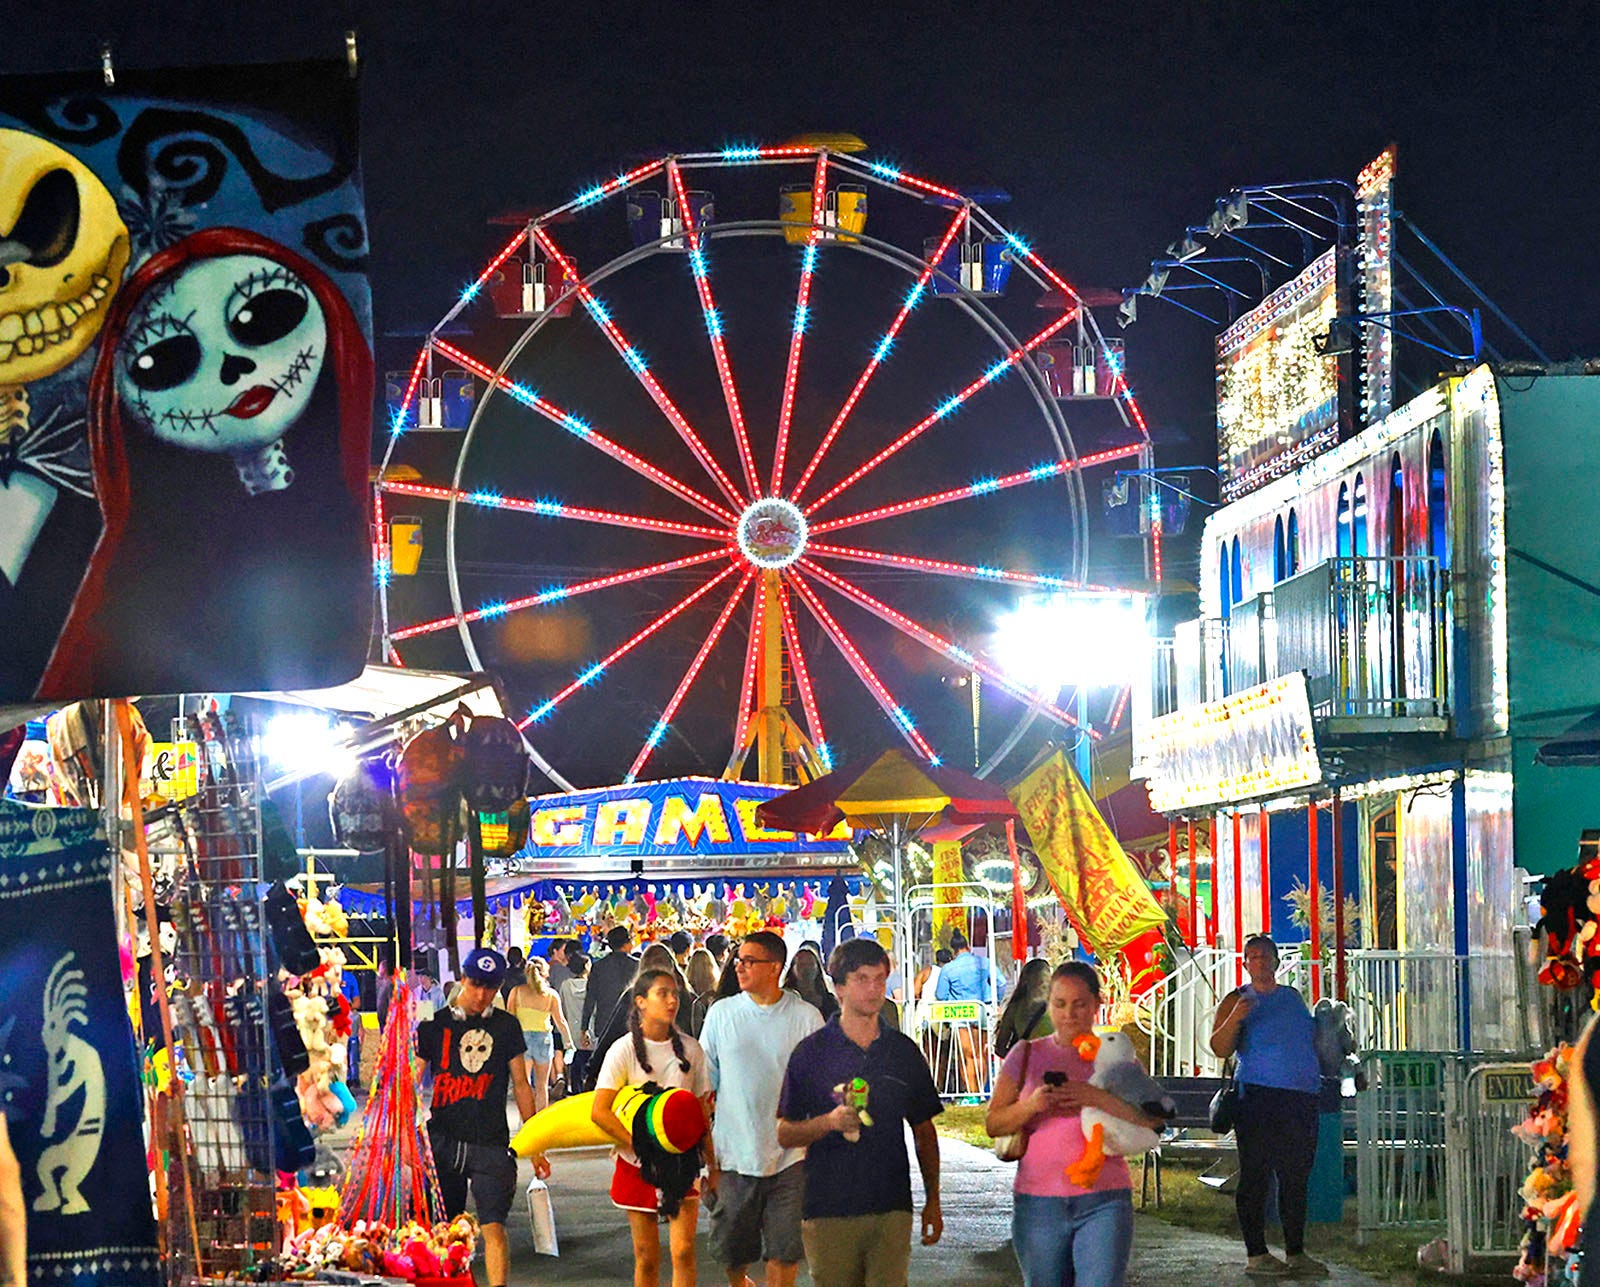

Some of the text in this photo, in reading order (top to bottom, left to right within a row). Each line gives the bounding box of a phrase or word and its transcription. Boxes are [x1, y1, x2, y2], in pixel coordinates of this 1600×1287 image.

[531, 793, 853, 848] GAME
[1094, 884, 1136, 934] MAKING
[482, 959, 492, 970] S
[944, 1005, 975, 1018] ENTER
[440, 1027, 452, 1070] I
[433, 1071, 495, 1108] FRIDAY
[1488, 1075, 1536, 1098] ENTRA
